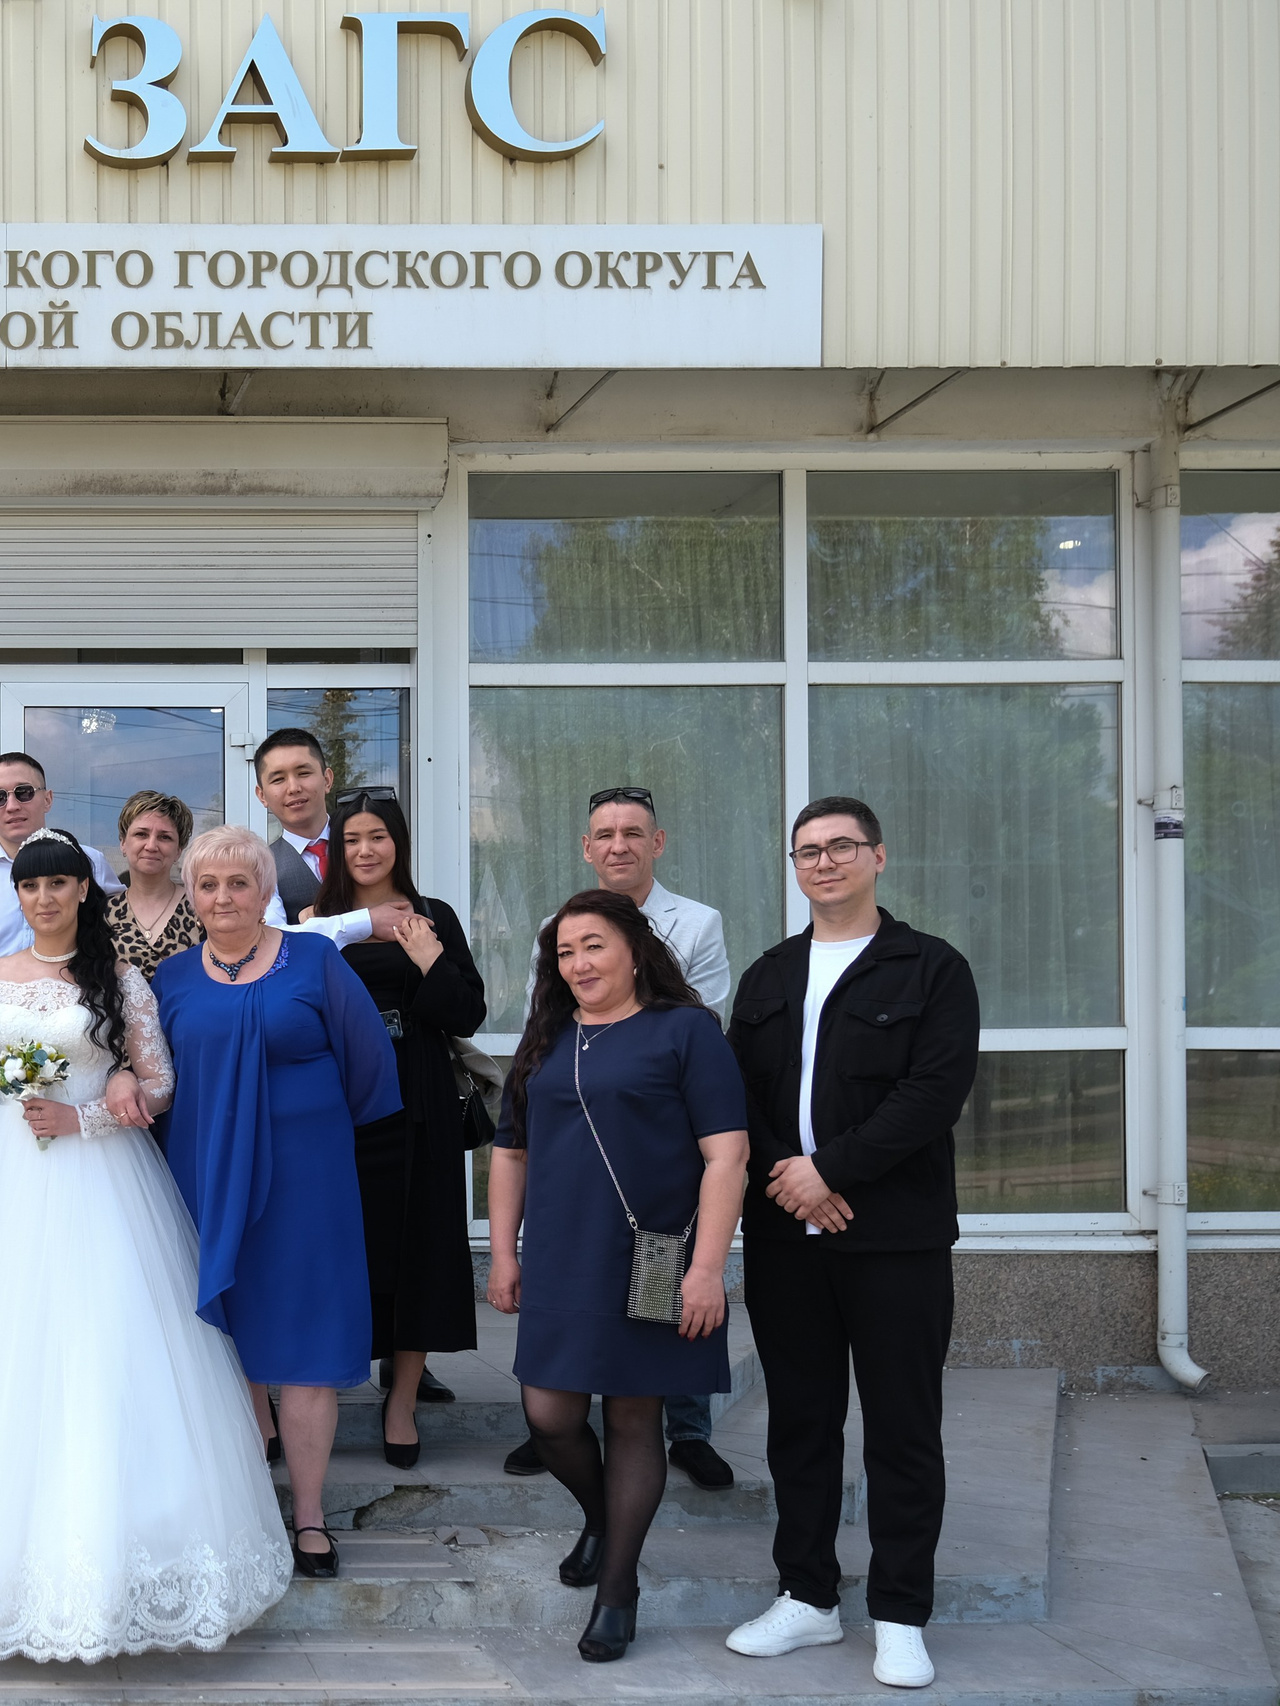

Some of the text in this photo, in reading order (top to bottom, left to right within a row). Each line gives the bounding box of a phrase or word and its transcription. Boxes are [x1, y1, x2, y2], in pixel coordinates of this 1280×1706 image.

[83, 8, 608, 170] ЗАГС
[173, 250, 542, 298] ГОРОДСКОГО
[554, 250, 767, 290] ОКРУГА
[111, 310, 373, 351] ОБЛАСТИ
